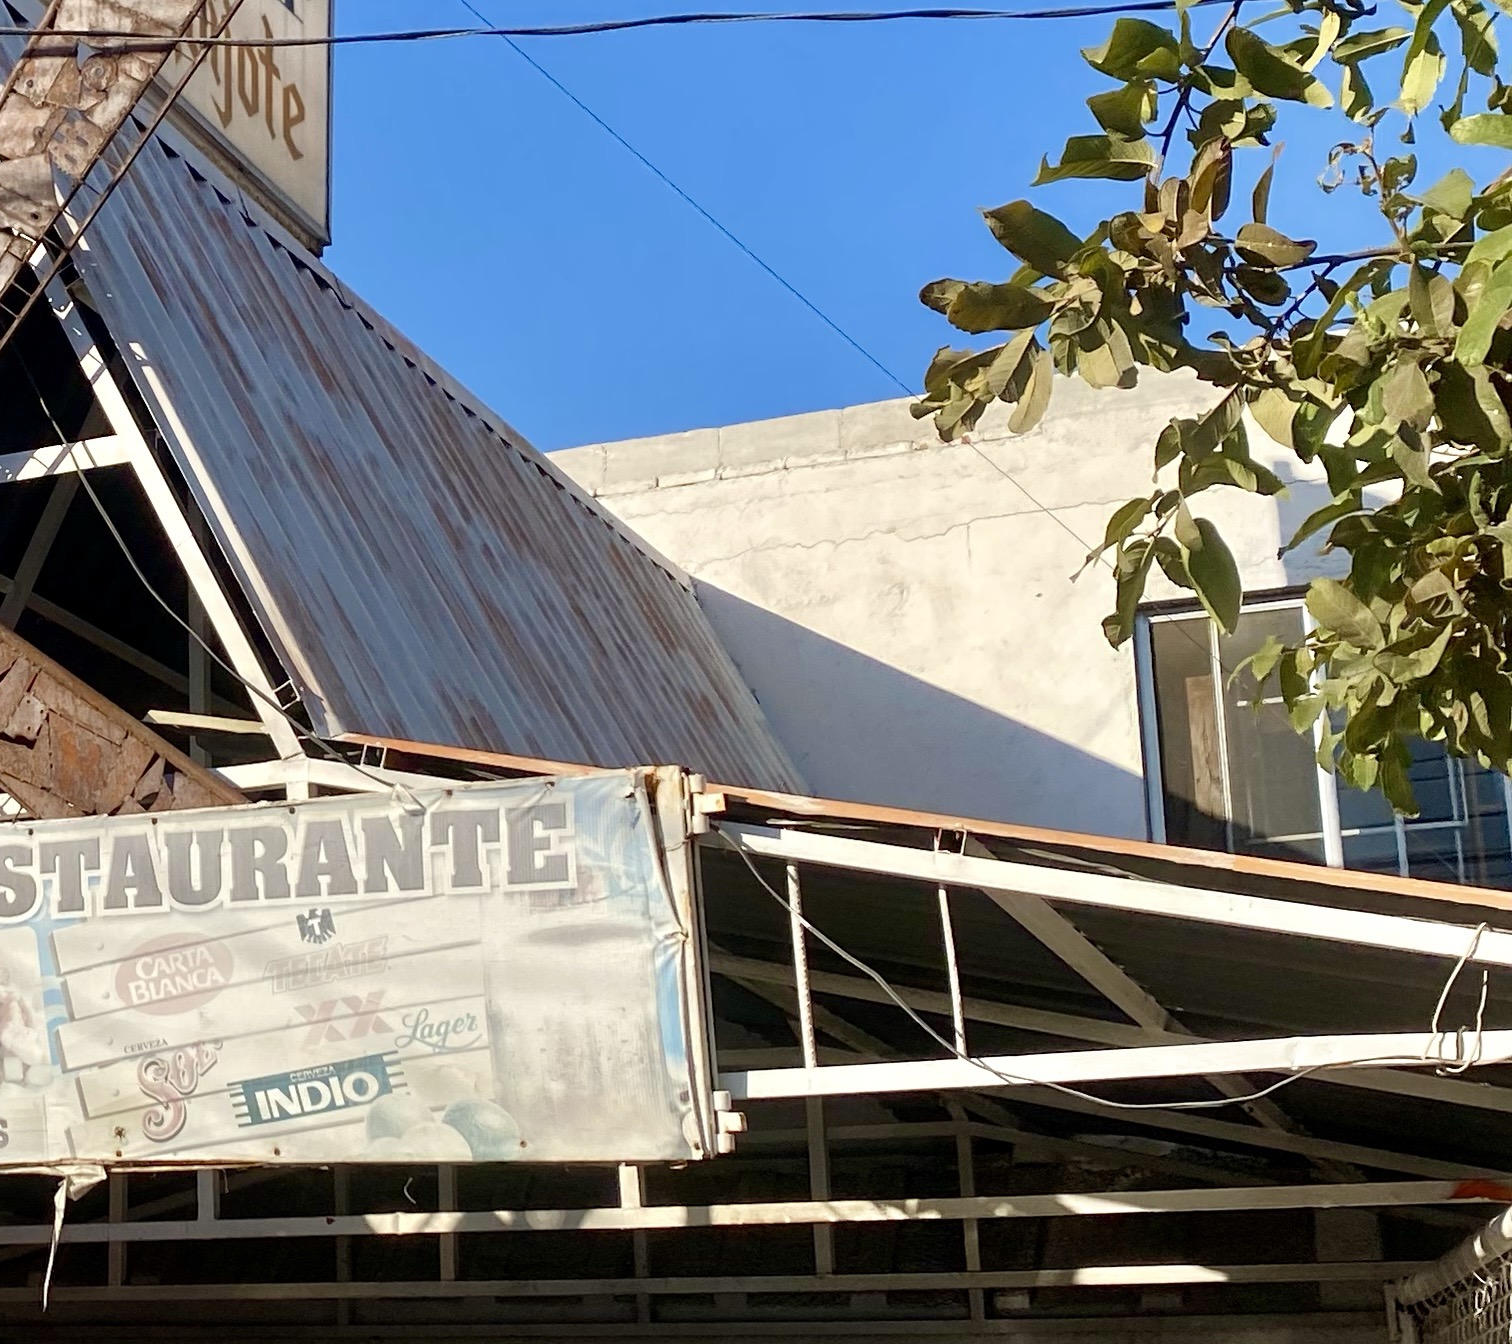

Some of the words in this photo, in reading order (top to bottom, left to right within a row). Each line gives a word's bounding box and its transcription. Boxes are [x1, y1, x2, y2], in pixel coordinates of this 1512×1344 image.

[135, 944, 215, 981] CARTA
[262, 935, 389, 995] TECATE
[127, 965, 226, 1006] BLANCA
[123, 1038, 169, 1055] CERVEZA
[395, 1008, 480, 1049] Lager
[289, 1065, 336, 1083] CERVEZA
[254, 1071, 380, 1121] INDIO
